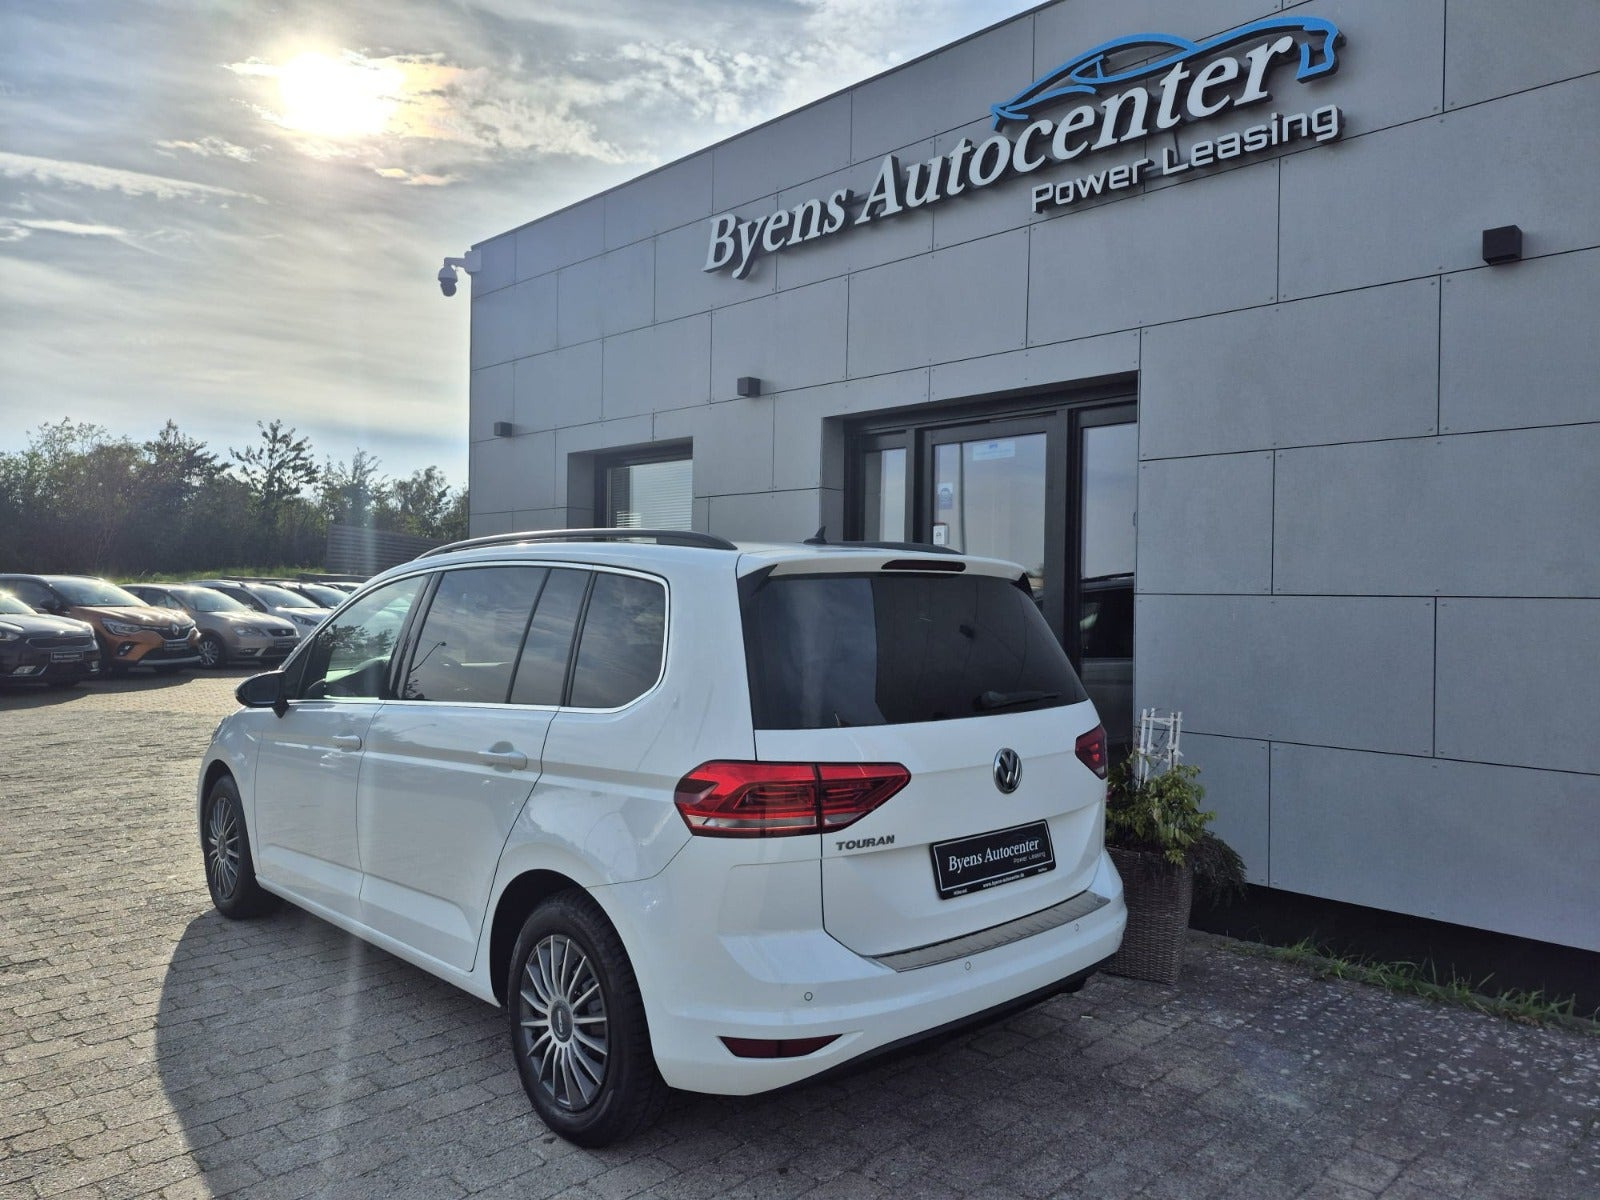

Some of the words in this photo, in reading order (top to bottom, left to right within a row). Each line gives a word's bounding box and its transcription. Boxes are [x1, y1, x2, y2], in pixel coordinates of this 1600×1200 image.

[702, 187, 848, 279] Byens
[855, 36, 1293, 225] Autocenter
[1031, 158, 1150, 213] Power
[1162, 104, 1340, 175] Leasing
[836, 834, 895, 851] TOURAN
[948, 853, 982, 873] Byens
[984, 840, 1039, 862] Autocenter
